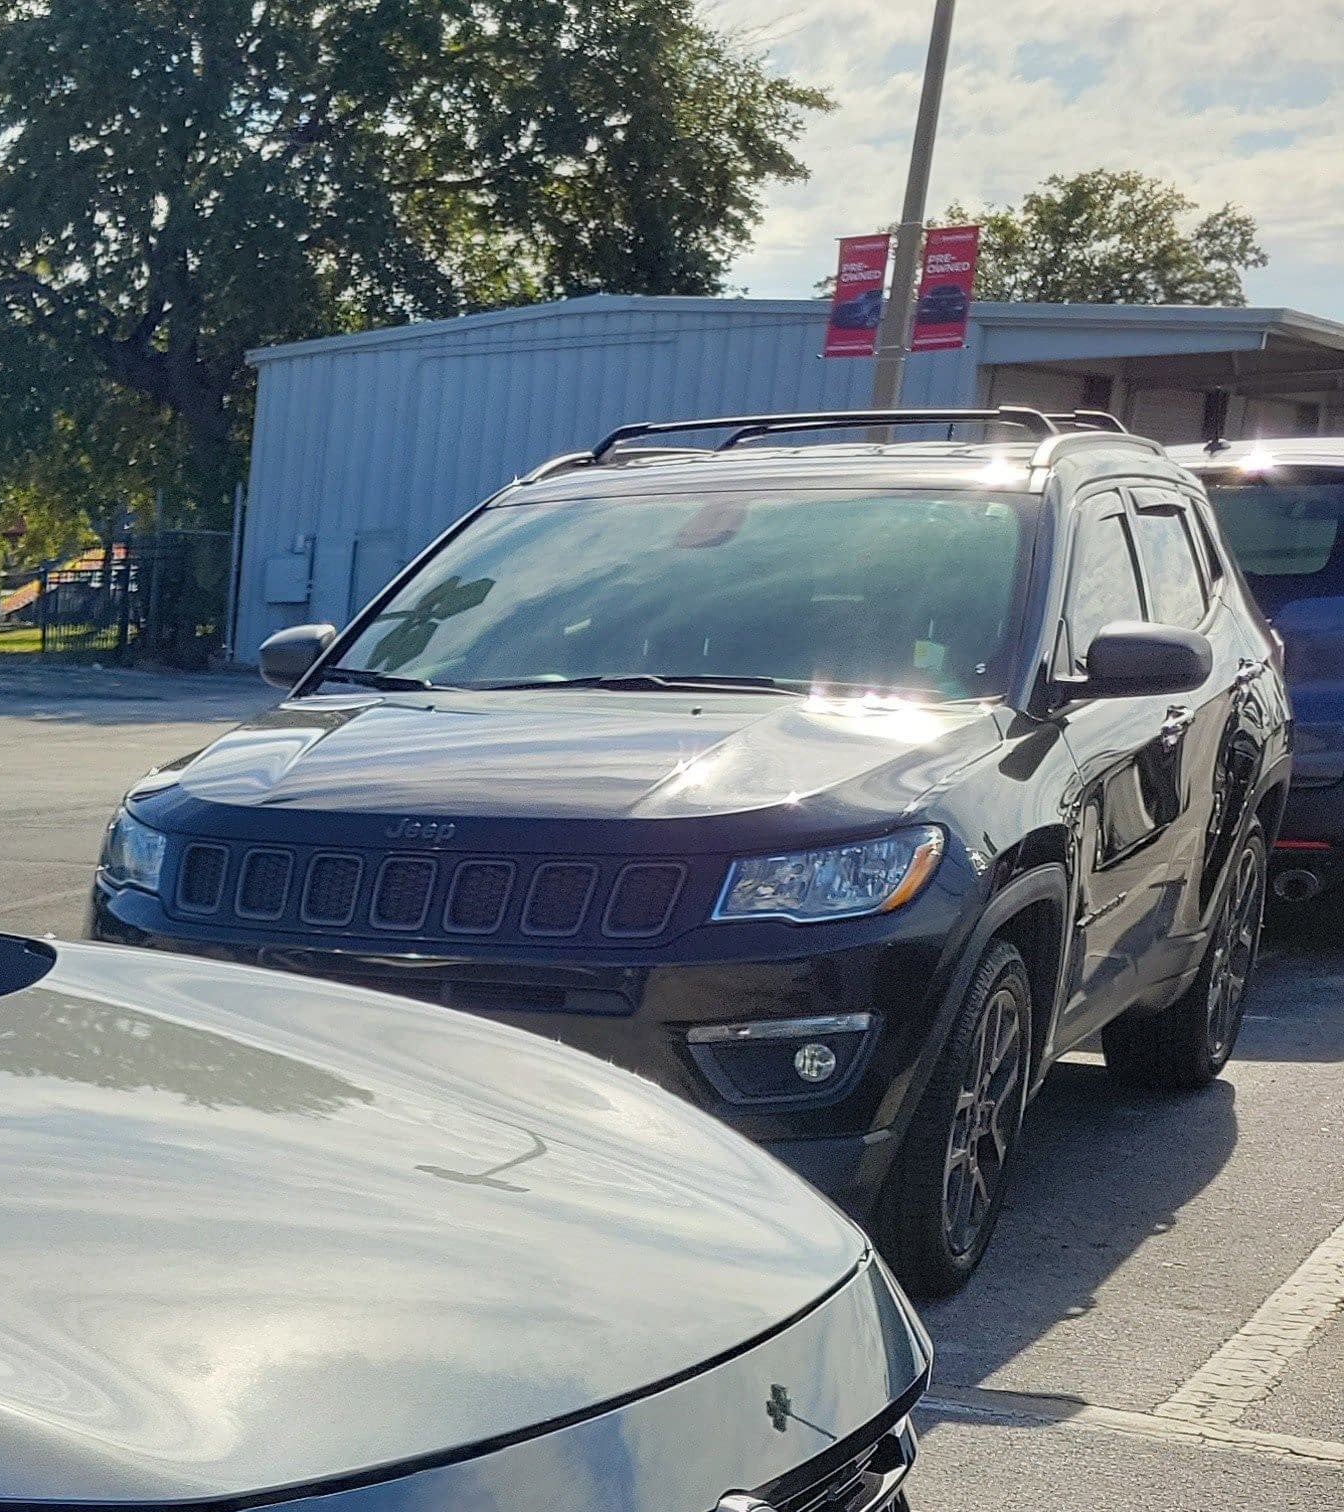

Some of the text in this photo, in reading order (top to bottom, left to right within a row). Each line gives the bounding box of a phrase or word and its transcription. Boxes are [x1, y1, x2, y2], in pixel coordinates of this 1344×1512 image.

[926, 261, 971, 274] OWNED
[841, 270, 881, 282] OWNED
[385, 817, 455, 843] Jeep
